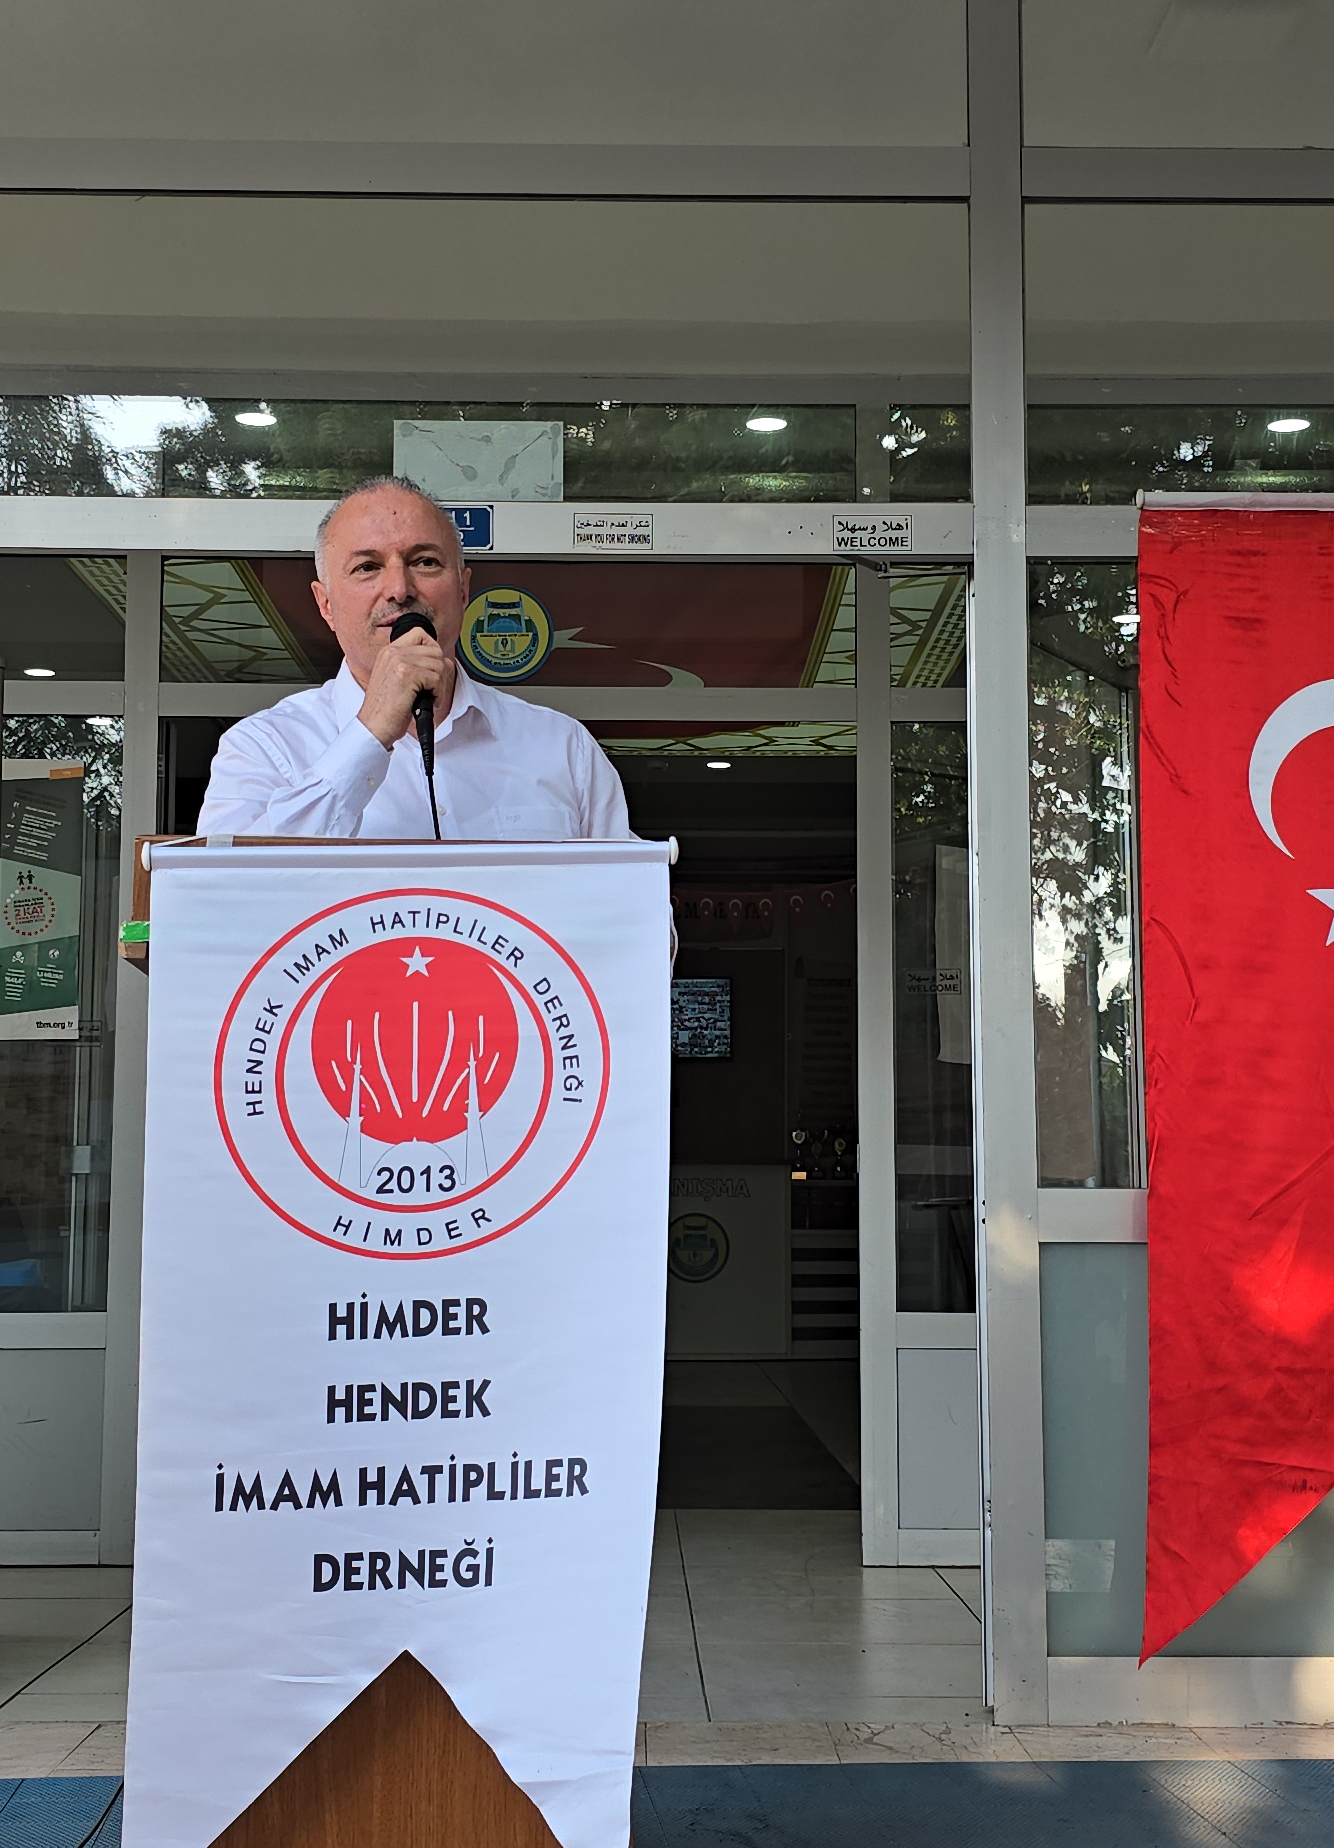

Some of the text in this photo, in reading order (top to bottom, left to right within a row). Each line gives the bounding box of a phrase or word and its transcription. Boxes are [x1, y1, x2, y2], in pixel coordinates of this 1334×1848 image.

[576, 533, 651, 544] THANK YOU FOR NOT SMOKING
[836, 536, 909, 548] WELCOME
[907, 984, 959, 993] WELCOME
[245, 997, 284, 1117] HENDEK
[376, 1164, 457, 1194] 2013
[327, 1292, 491, 1342] HİMDER
[326, 1378, 492, 1425] HENDEK
[214, 1451, 590, 1513] İMAM HATİPLİLER
[313, 1537, 495, 1592] DERNEĞİ
